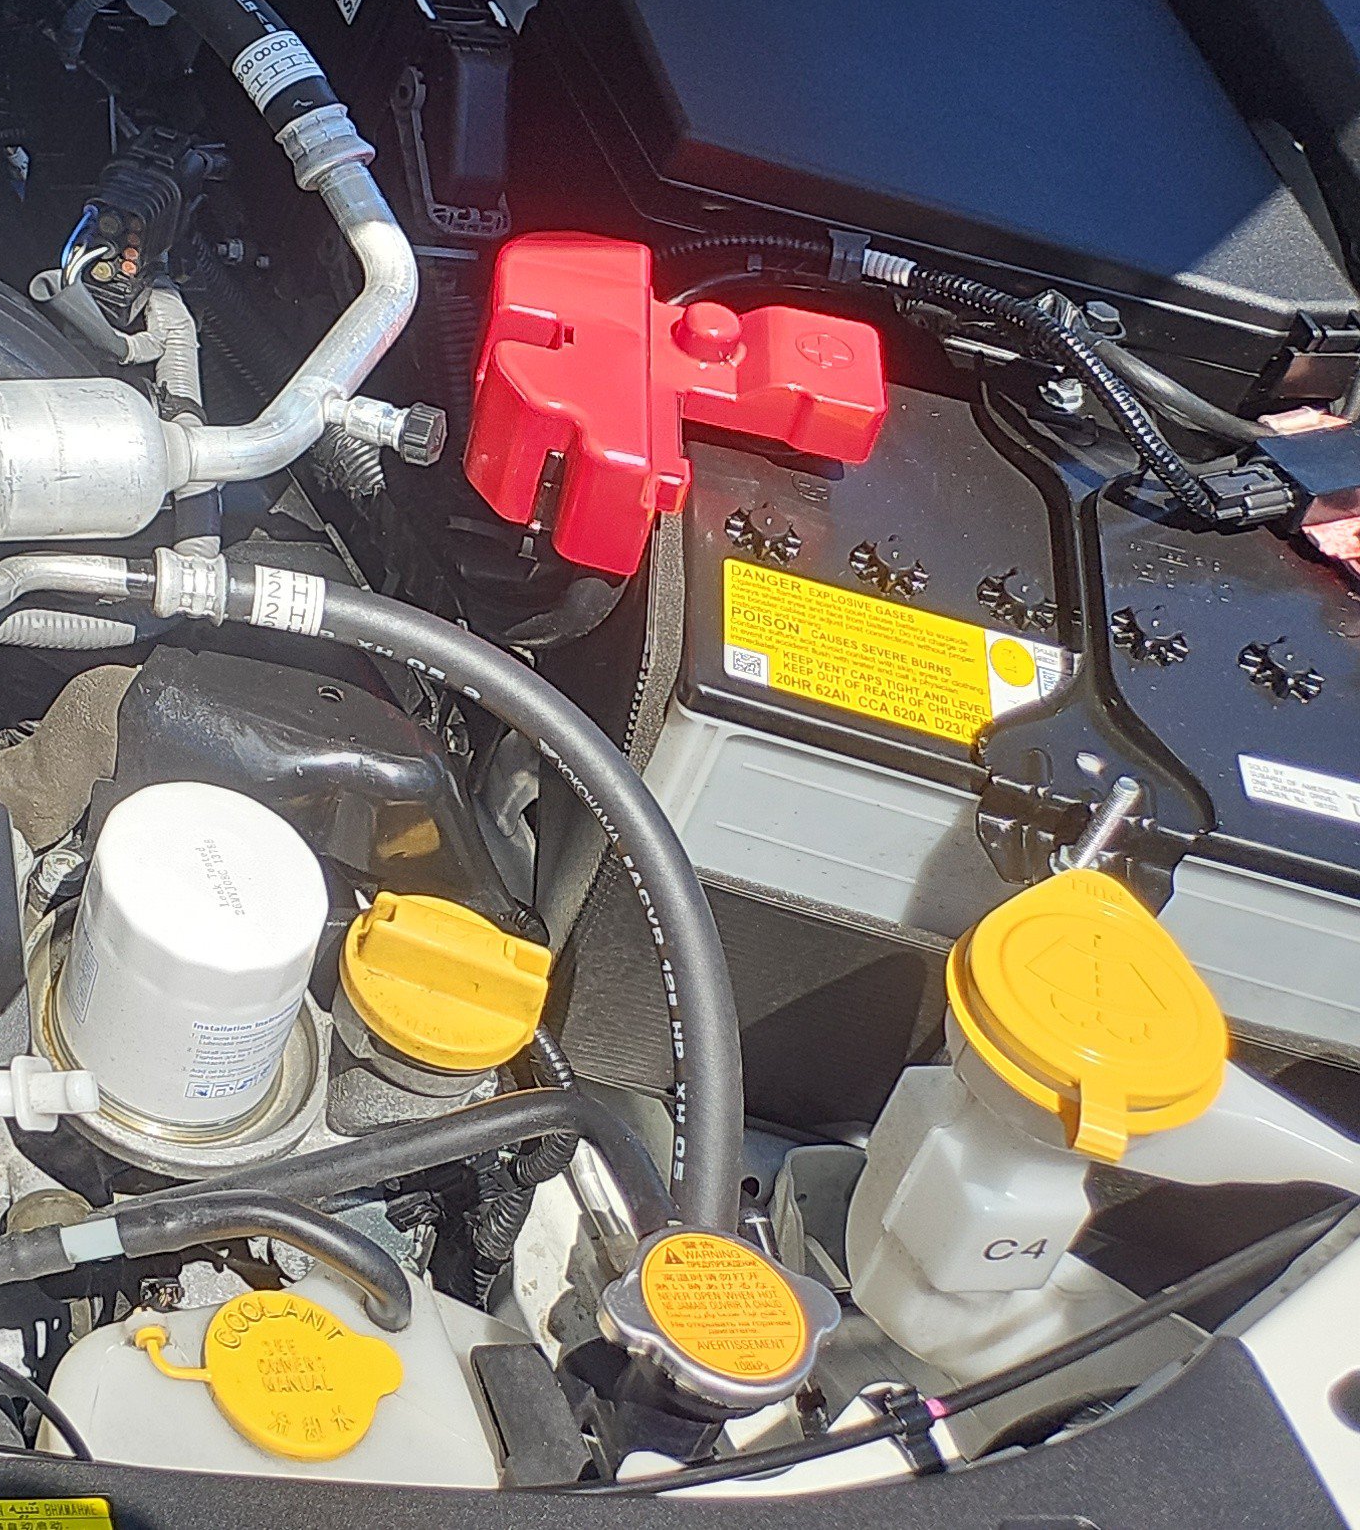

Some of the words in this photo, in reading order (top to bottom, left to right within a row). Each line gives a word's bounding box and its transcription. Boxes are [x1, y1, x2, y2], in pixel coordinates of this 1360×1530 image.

[730, 564, 802, 593] DANGER
[808, 587, 872, 612] EXPLOSIVE
[875, 605, 915, 624] GASES
[730, 606, 801, 635] POISON
[810, 629, 859, 650] CAUSES
[861, 642, 909, 664] SEVERE
[911, 656, 953, 677] BURNS
[775, 671, 812, 694] 20HR
[814, 683, 851, 705] 62Ah
[858, 695, 890, 716] CCA
[892, 706, 928, 726] 620A
[782, 650, 814, 666] KEEP
[816, 659, 847, 677] VENT
[850, 668, 882, 686] CAPS
[885, 679, 921, 697] TIGHT
[923, 689, 949, 706] AND
[951, 696, 990, 717] LEVEL
[782, 660, 814, 677] KEEP
[817, 670, 843, 686] OUT
[844, 678, 861, 691] OF
[863, 682, 905, 704] REACH
[908, 695, 925, 709] OF
[556, 756, 622, 845] YOKOHAMA
[192, 1022, 253, 1033] Installation
[674, 1081, 687, 1125] XH
[673, 1135, 687, 1182] 05
[682, 1249, 741, 1260] WARNING
[981, 1236, 1048, 1264] C4
[658, 1291, 690, 1301] NEVER
[691, 1291, 722, 1300] OPEN
[723, 1290, 757, 1300] WHEN
[662, 1301, 675, 1310] NE
[676, 1300, 708, 1310] JAMAIS
[213, 1296, 345, 1349] COOLANT
[696, 1339, 786, 1351] AVERTISSEMENT
[734, 1360, 770, 1371] 108kPa
[260, 1373, 334, 1393] MANUAL
